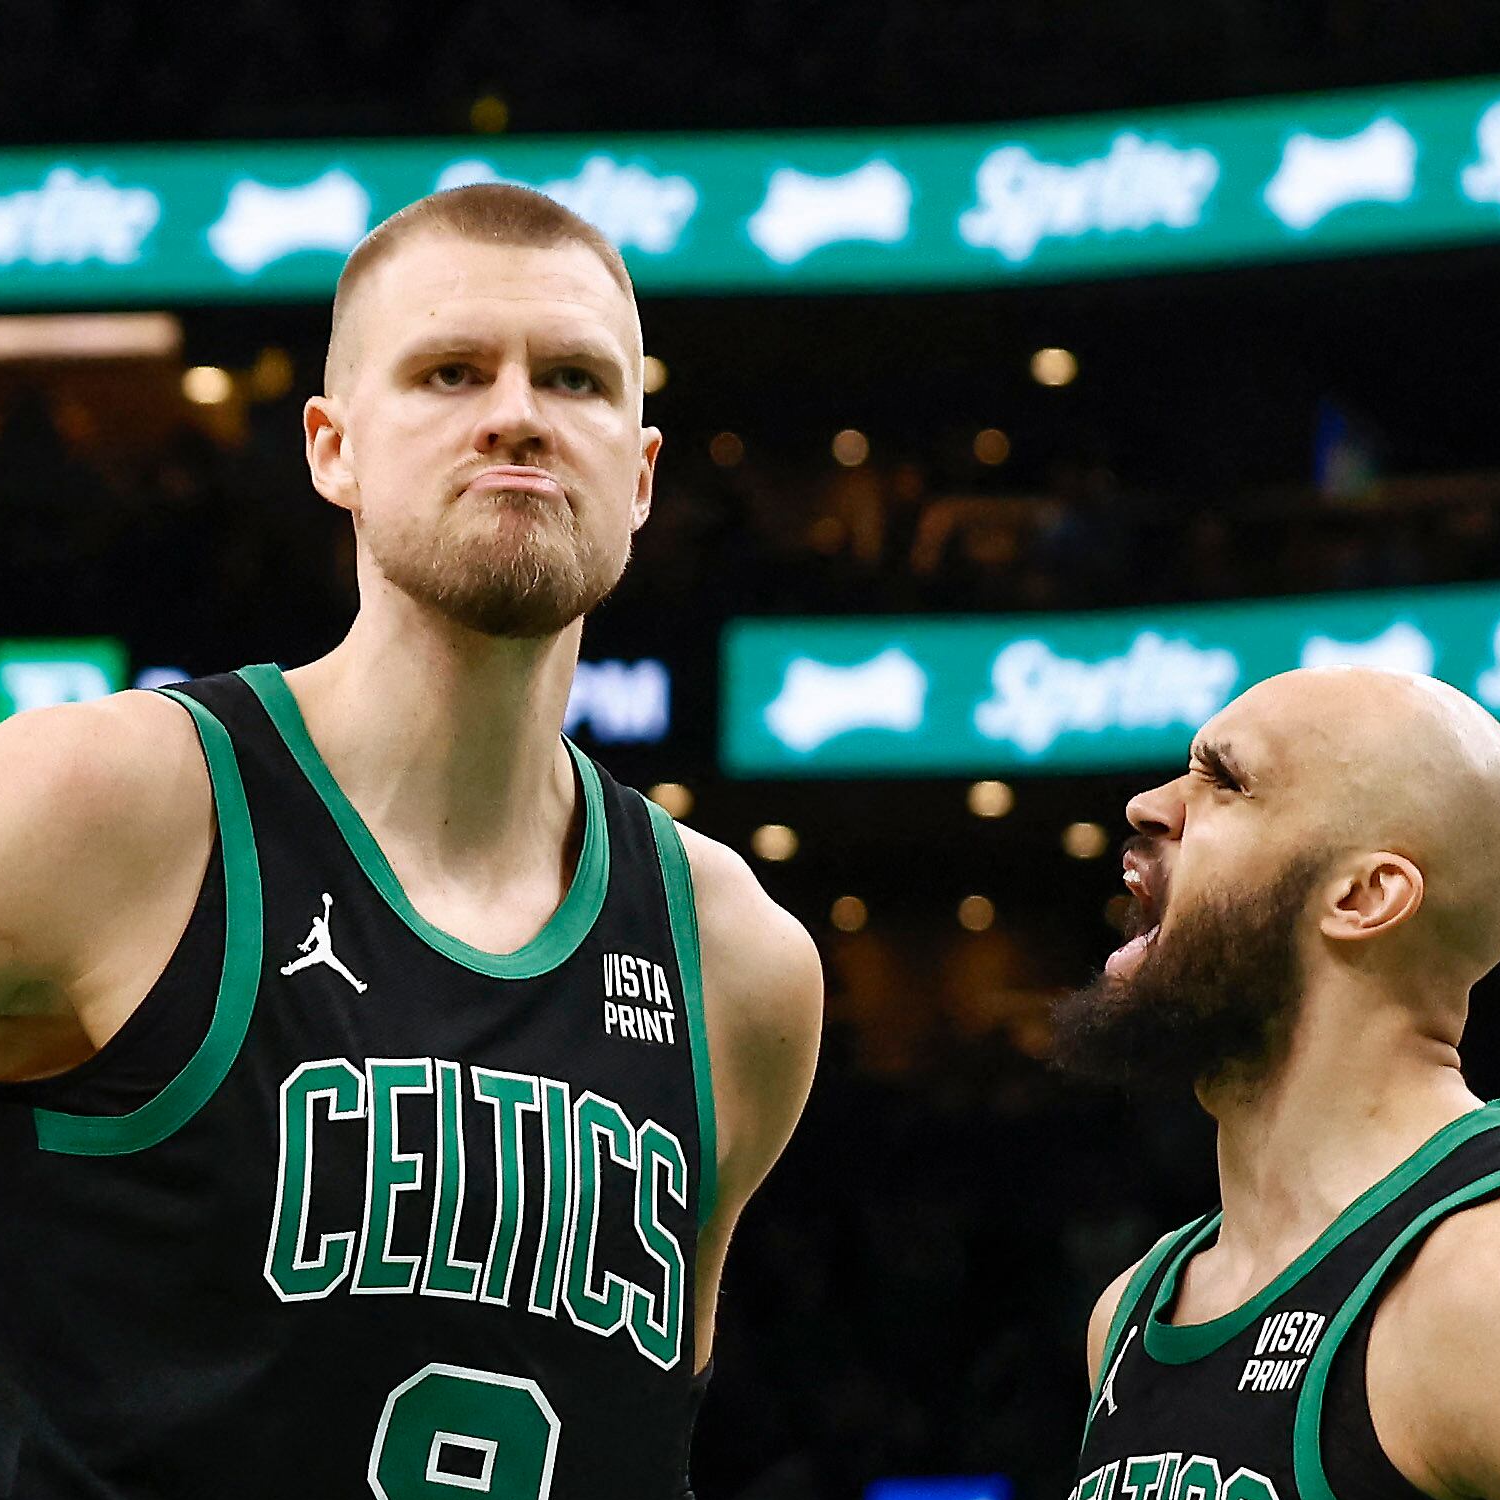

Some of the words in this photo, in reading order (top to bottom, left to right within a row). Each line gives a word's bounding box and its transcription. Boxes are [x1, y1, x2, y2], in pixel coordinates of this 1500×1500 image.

[960, 136, 1218, 259] Sprite
[603, 953, 673, 1010] VISTA
[604, 1000, 675, 1044] PRINT
[264, 1057, 687, 1370] CELTICS
[1253, 1311, 1326, 1355] VISTA
[1237, 1358, 1307, 1391] PRINT
